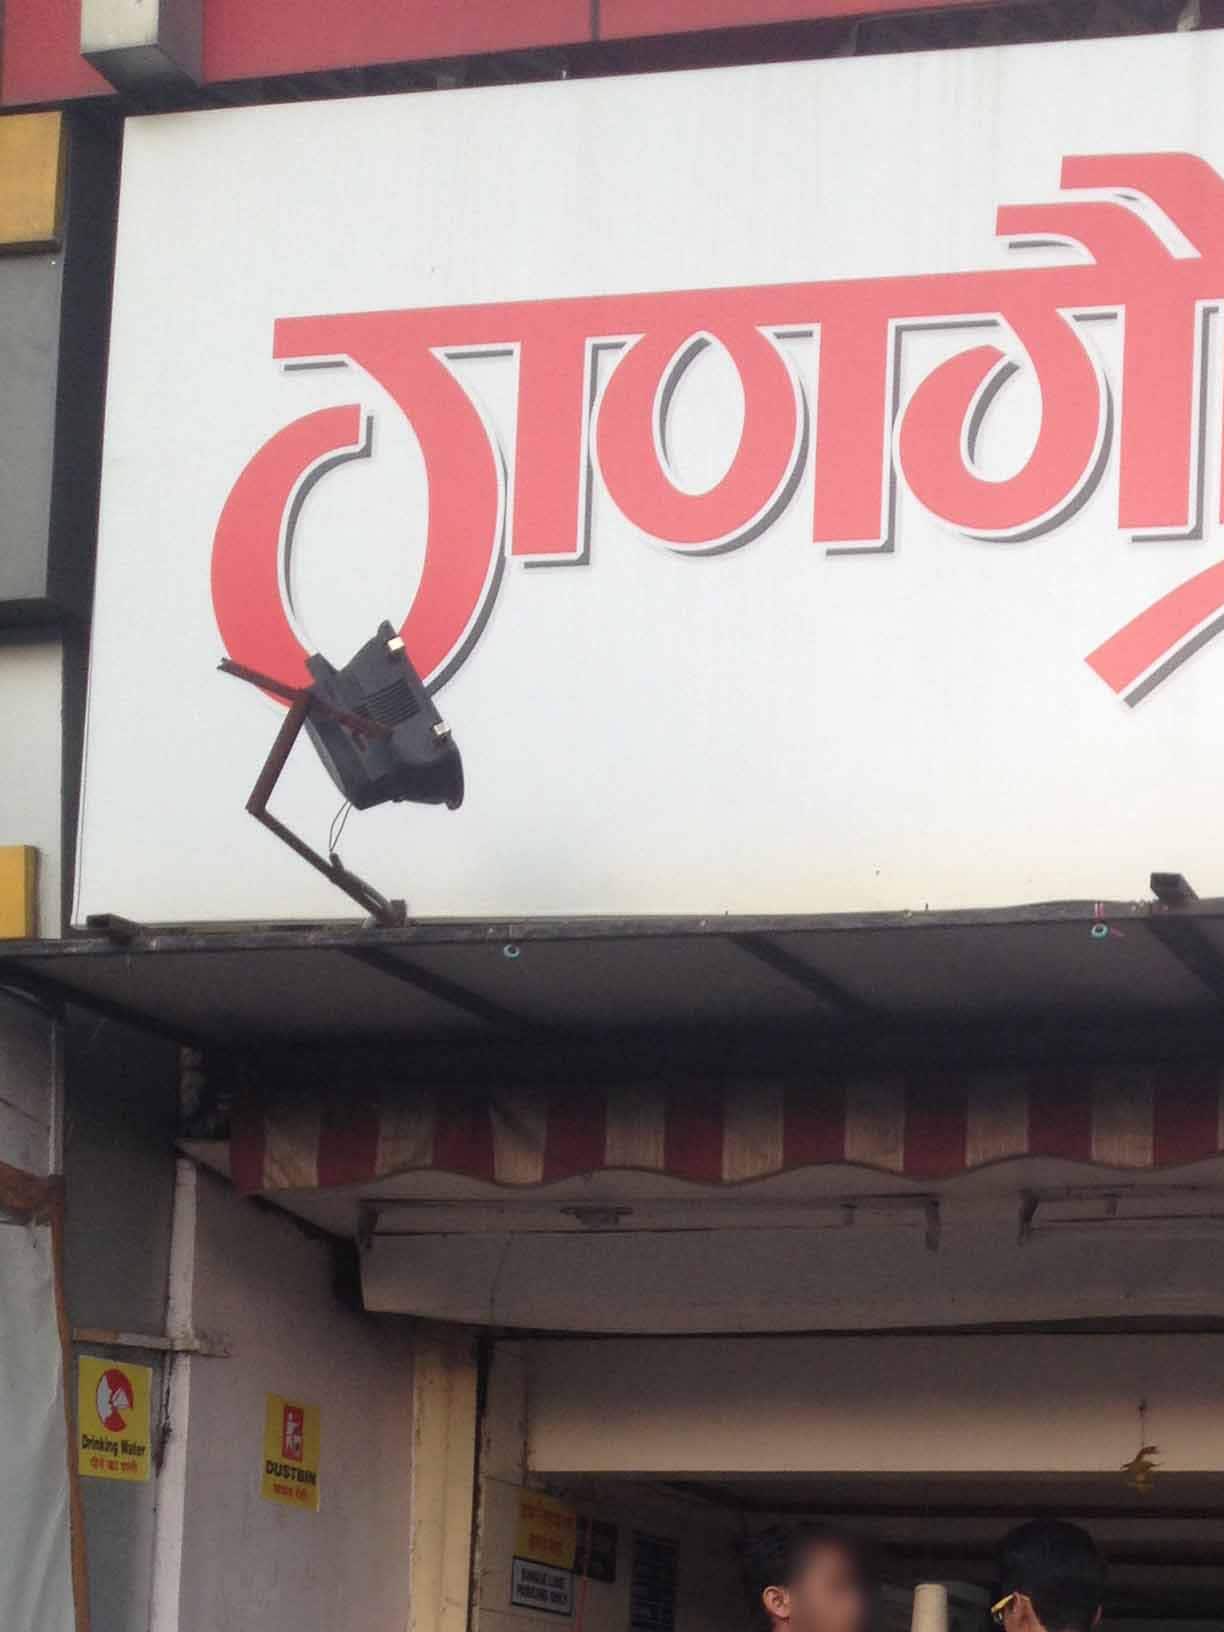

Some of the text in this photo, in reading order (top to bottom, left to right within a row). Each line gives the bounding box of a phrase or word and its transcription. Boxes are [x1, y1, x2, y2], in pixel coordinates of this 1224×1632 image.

[81, 1434, 146, 1457] Drinking Water
[265, 1459, 317, 1486] DUSTBIN
